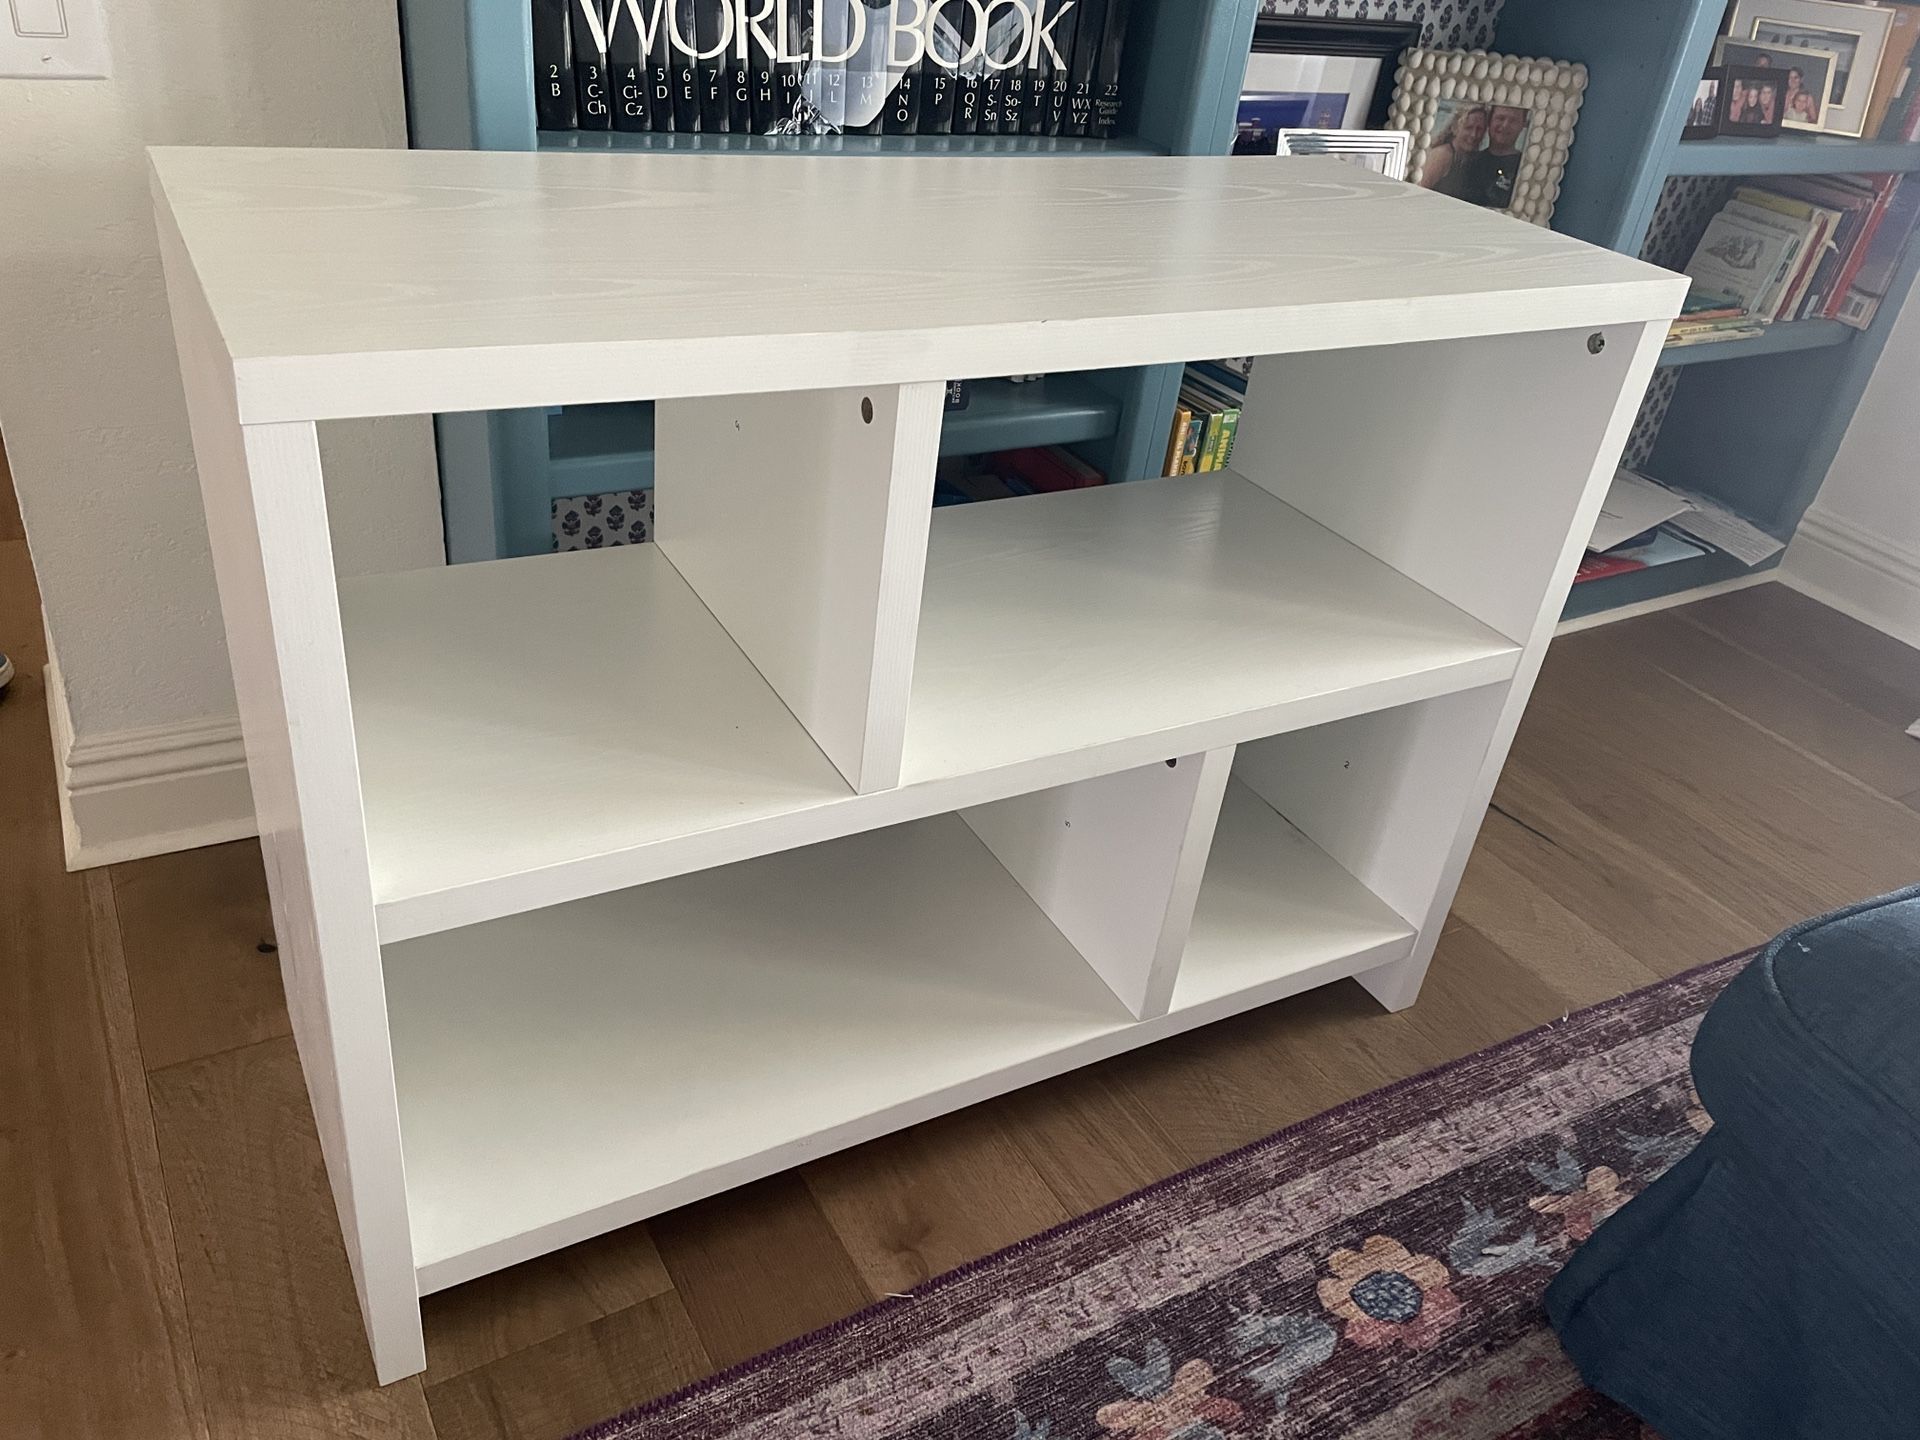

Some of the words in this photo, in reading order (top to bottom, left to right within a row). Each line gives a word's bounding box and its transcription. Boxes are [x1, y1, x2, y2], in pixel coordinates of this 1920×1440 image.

[580, 0, 866, 63] WORLD
[887, 0, 1076, 71] BOOK
[549, 64, 559, 79] 2
[589, 66, 598, 80] 3
[627, 67, 636, 81] 4
[657, 67, 665, 81] 5
[682, 68, 691, 82] 6
[709, 69, 717, 82] 7
[737, 70, 745, 84] 8
[761, 71, 769, 84] 9
[781, 74, 796, 88] 10
[829, 74, 840, 87] 12
[861, 76, 873, 89] 13
[899, 77, 911, 90] 14
[935, 77, 946, 90] 15
[966, 78, 978, 89] 16
[989, 79, 1001, 91] 17
[1010, 79, 1022, 91] 18
[1034, 80, 1046, 92] 19
[1053, 80, 1067, 93] 20
[551, 82, 561, 97] B
[587, 84, 604, 98] C-
[623, 85, 643, 99] Ci-
[656, 85, 668, 99] D
[684, 86, 692, 100] E
[711, 86, 718, 100] F
[736, 87, 747, 101] G
[760, 88, 771, 101] H
[1076, 82, 1089, 95] 21
[1104, 84, 1118, 96] 22
[830, 90, 838, 103] L
[860, 92, 872, 105] M
[898, 94, 909, 107] N
[935, 93, 943, 105] P
[964, 92, 976, 107] Q
[987, 94, 998, 107] S-
[1004, 95, 1022, 107] So-
[1034, 95, 1041, 107] T
[1054, 95, 1063, 108] U
[587, 100, 607, 115] Ch
[625, 102, 644, 116] Cz
[1072, 97, 1091, 110] WX
[897, 108, 909, 121] O
[964, 107, 972, 119] R
[984, 109, 997, 121] Sn
[1005, 109, 1018, 121] Sz
[1053, 110, 1061, 122] V
[1072, 111, 1088, 124] YZ
